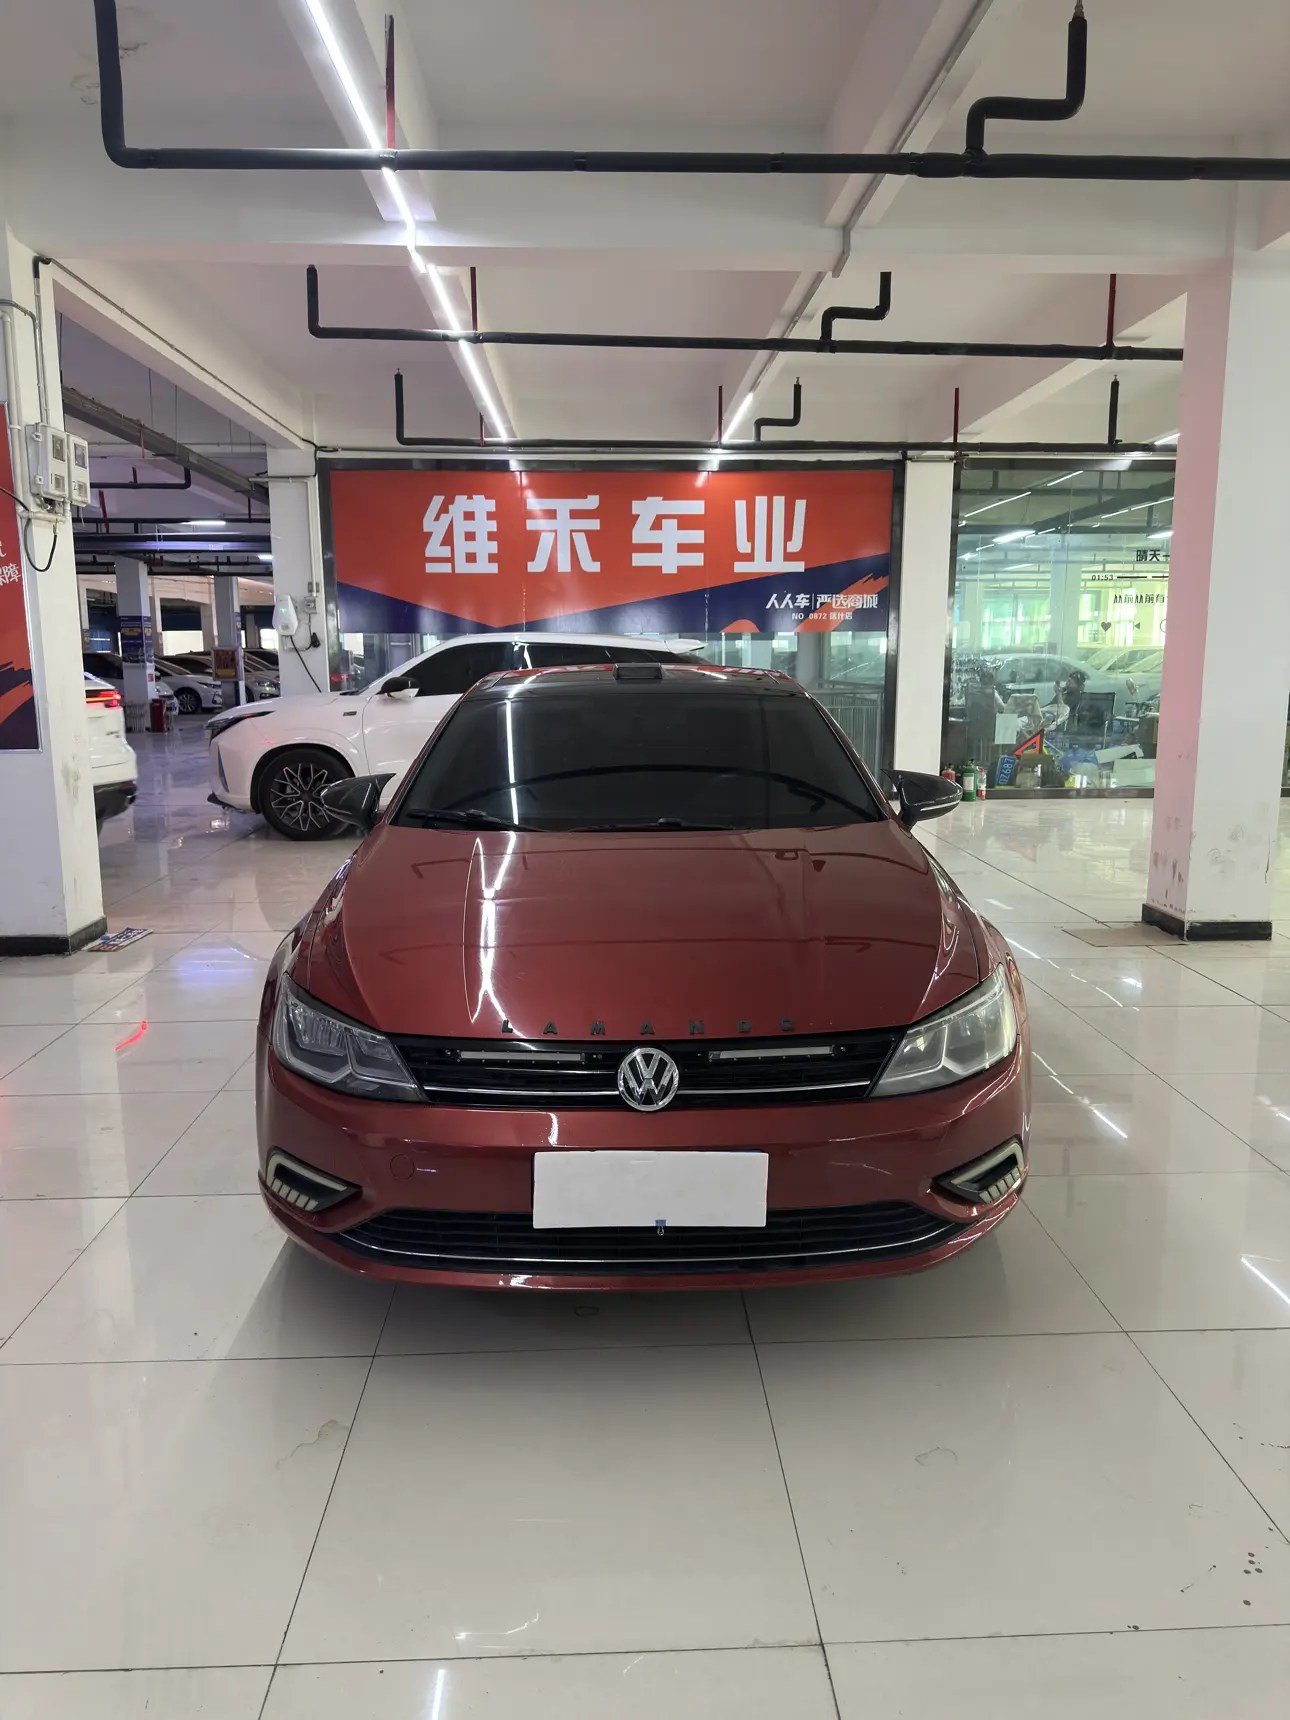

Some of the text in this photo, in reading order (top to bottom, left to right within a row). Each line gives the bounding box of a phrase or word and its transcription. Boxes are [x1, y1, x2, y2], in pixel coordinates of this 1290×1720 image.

[423, 495, 807, 575] 维禾车业
[1091, 574, 1114, 582] 01:53
[765, 593, 878, 609] 人人车 严选商城
[808, 612, 828, 620] 0872
